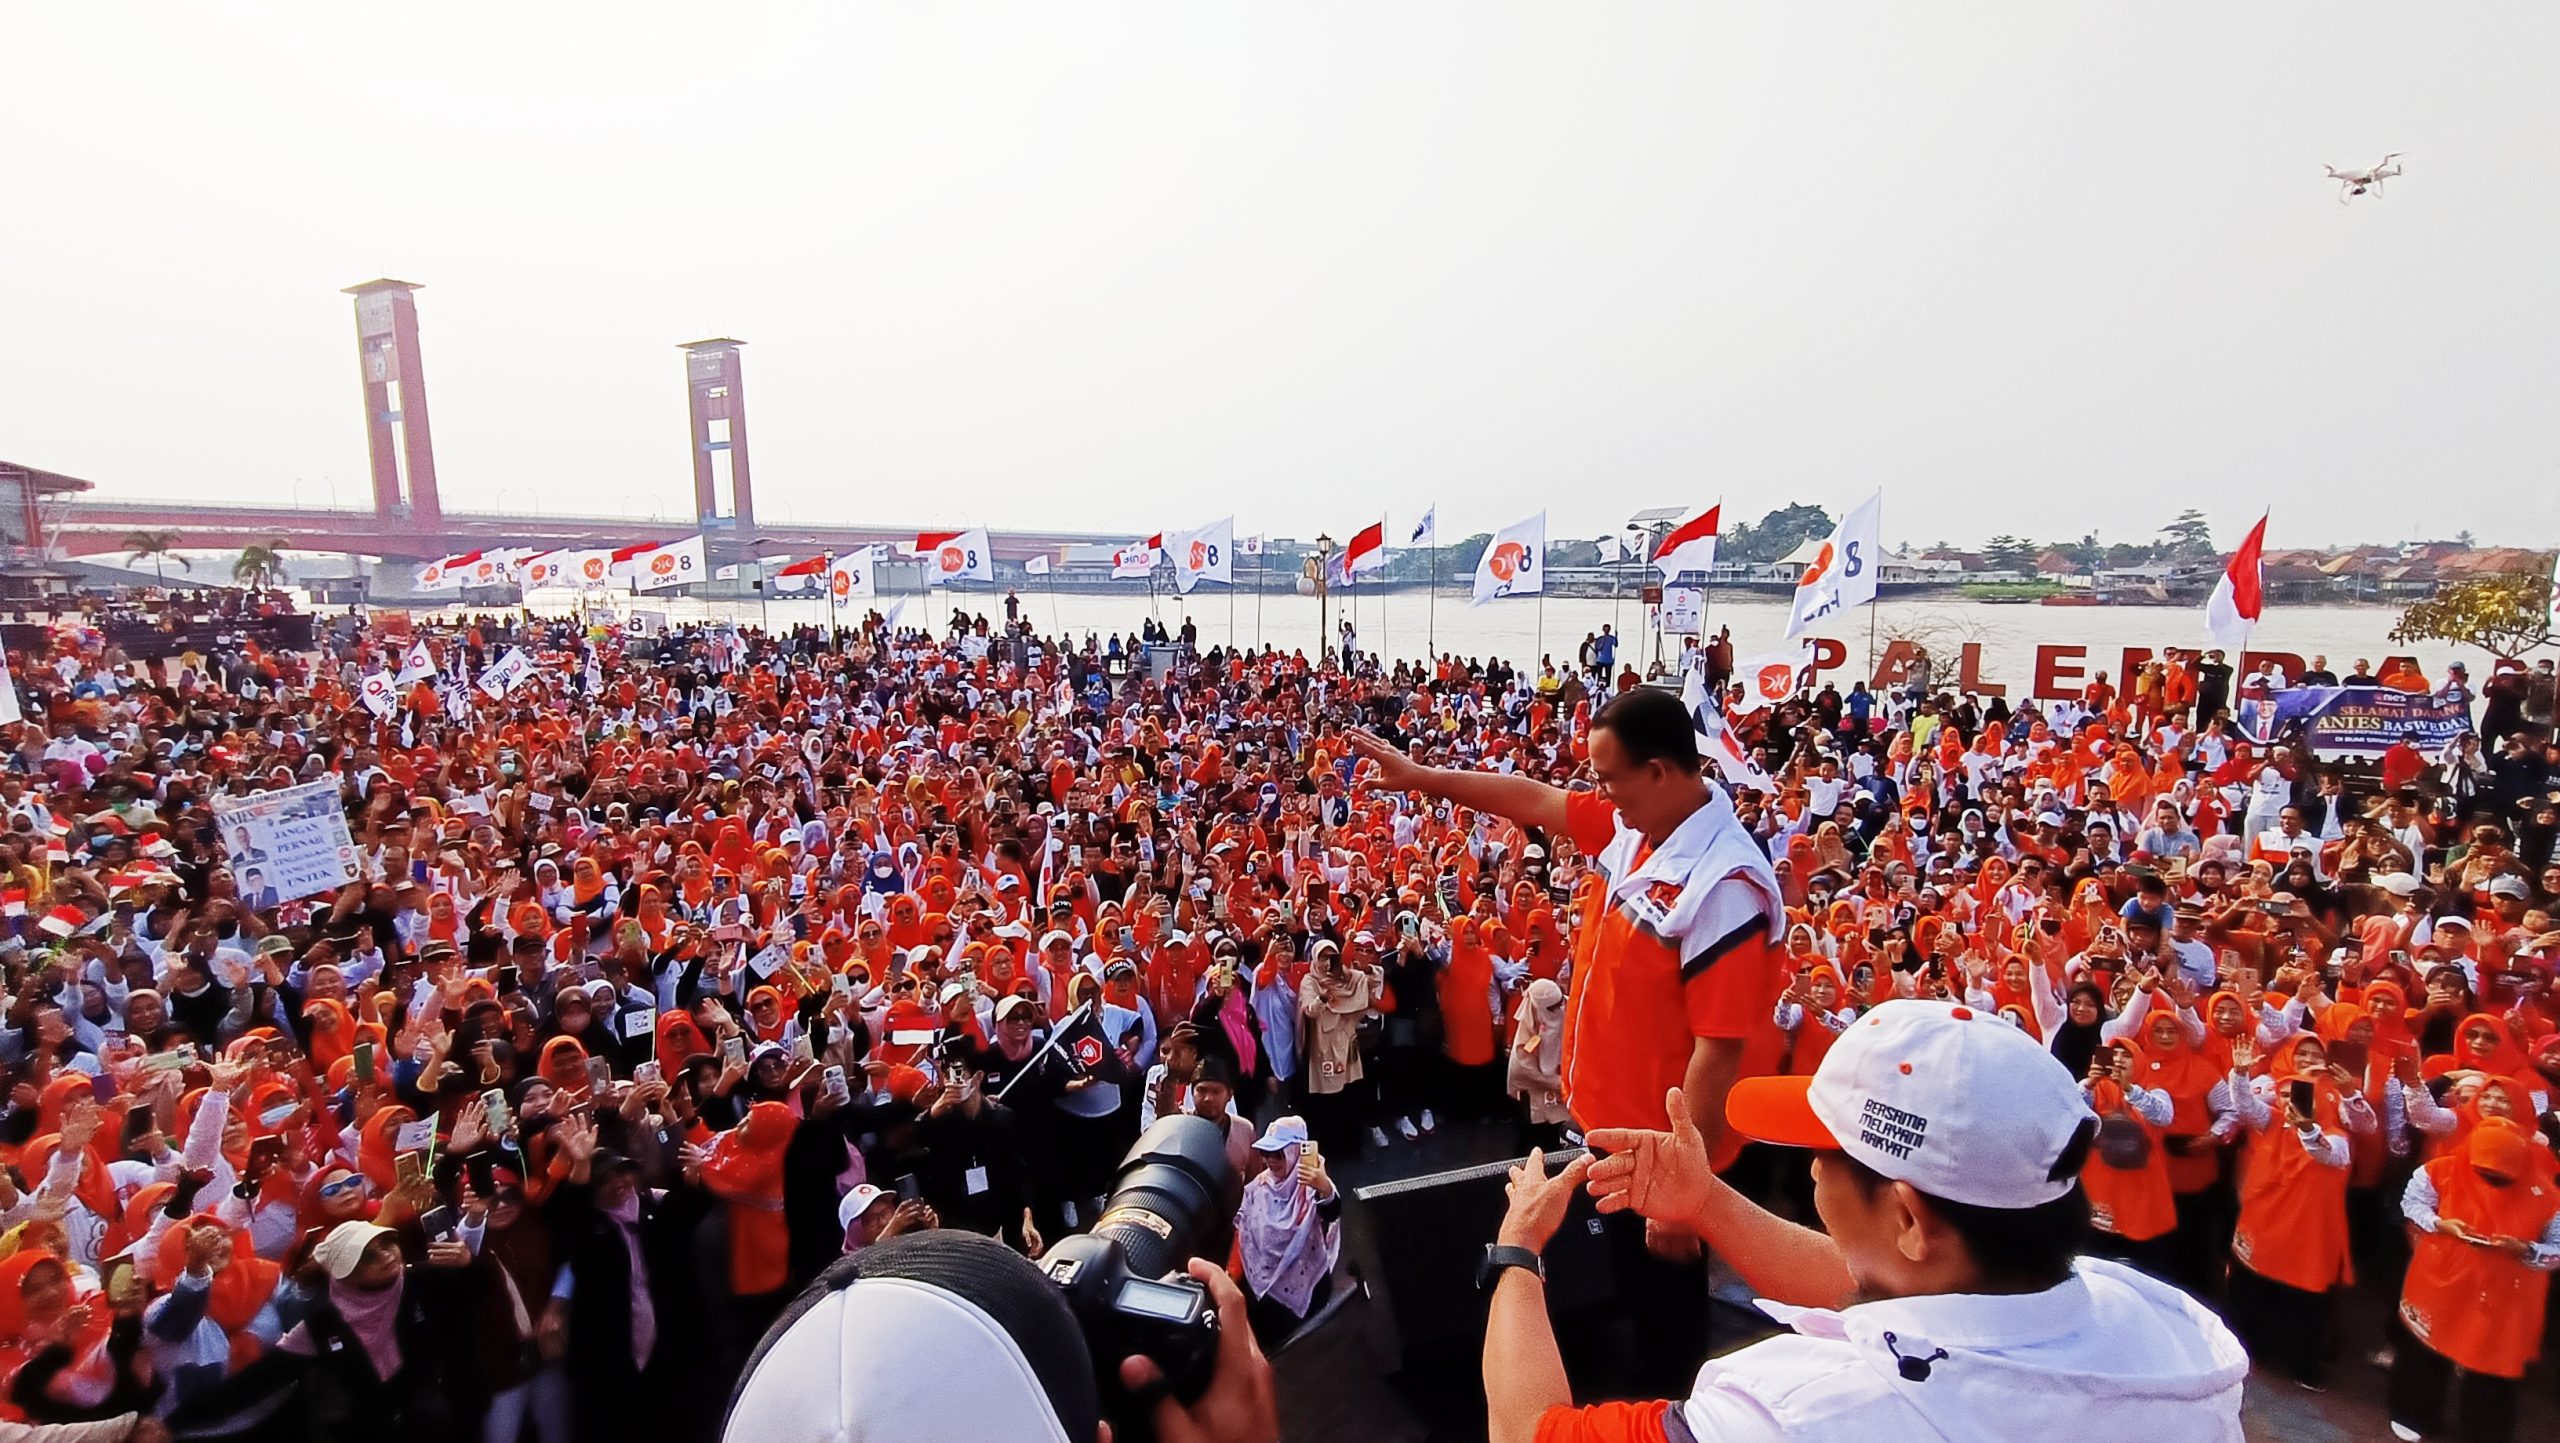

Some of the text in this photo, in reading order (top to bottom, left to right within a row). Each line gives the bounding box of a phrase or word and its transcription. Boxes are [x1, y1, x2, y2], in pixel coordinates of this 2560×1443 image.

[680, 555, 692, 571] 8
[966, 550, 978, 569] 8
[1207, 544, 1219, 566] 8
[1845, 541, 1862, 578] 8
[496, 562, 505, 574] 8
[550, 564, 558, 577] 8
[629, 618, 643, 632] 8
[2340, 704, 2464, 718] SELAMAT DATANG
[2316, 716, 2470, 732] ANIES BASWEDAN
[274, 823, 320, 840] JANGAN
[287, 870, 332, 887] UNTUK
[1864, 1099, 1928, 1132] BERSAMA
[1859, 1113, 1925, 1148] MELAYANI
[1861, 1130, 1914, 1160] RAKYAT
